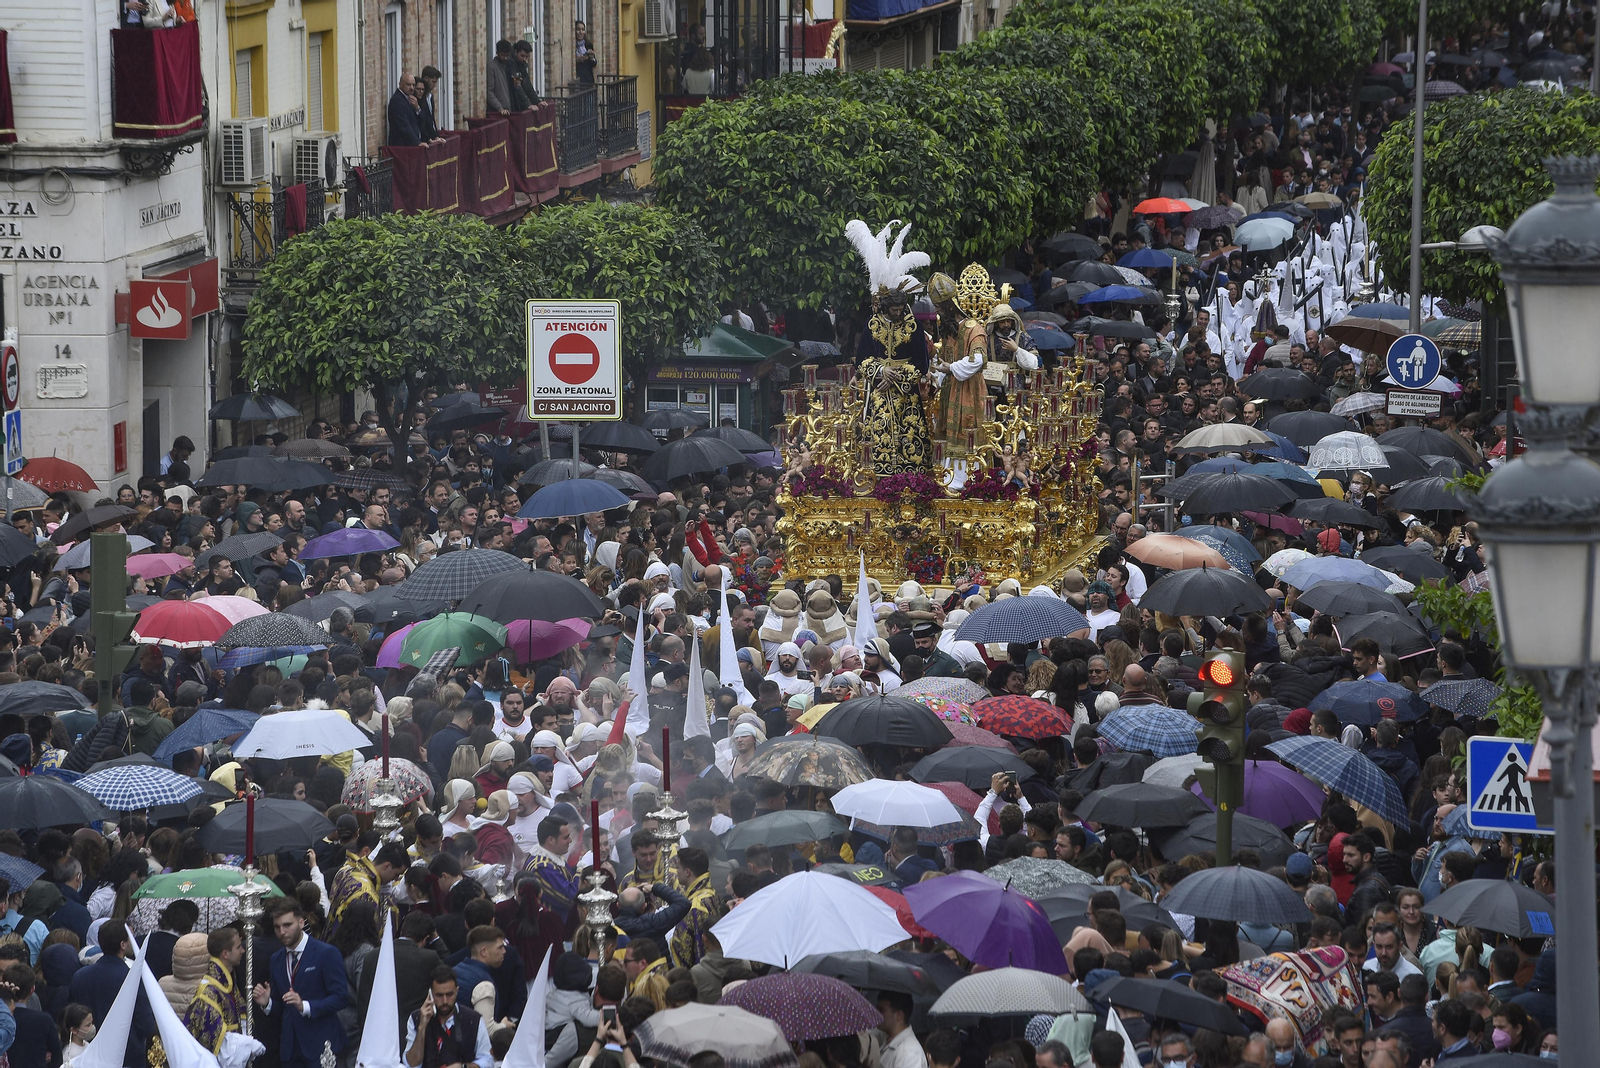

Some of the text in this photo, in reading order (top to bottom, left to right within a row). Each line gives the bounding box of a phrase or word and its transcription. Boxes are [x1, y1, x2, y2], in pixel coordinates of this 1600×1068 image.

[270, 110, 304, 130] SAN JACINTO
[141, 201, 182, 226] SAN JACINTO
[1, 245, 62, 259] ZANO
[23, 275, 100, 289] AGENCIA
[23, 292, 92, 307] URBANA
[545, 320, 607, 331] ATENCIÓN
[54, 344, 72, 359] 14
[564, 387, 612, 395] PEATONAL
[538, 403, 611, 411] C/ SAN JACINTO
[1220, 802, 1228, 811] 6
